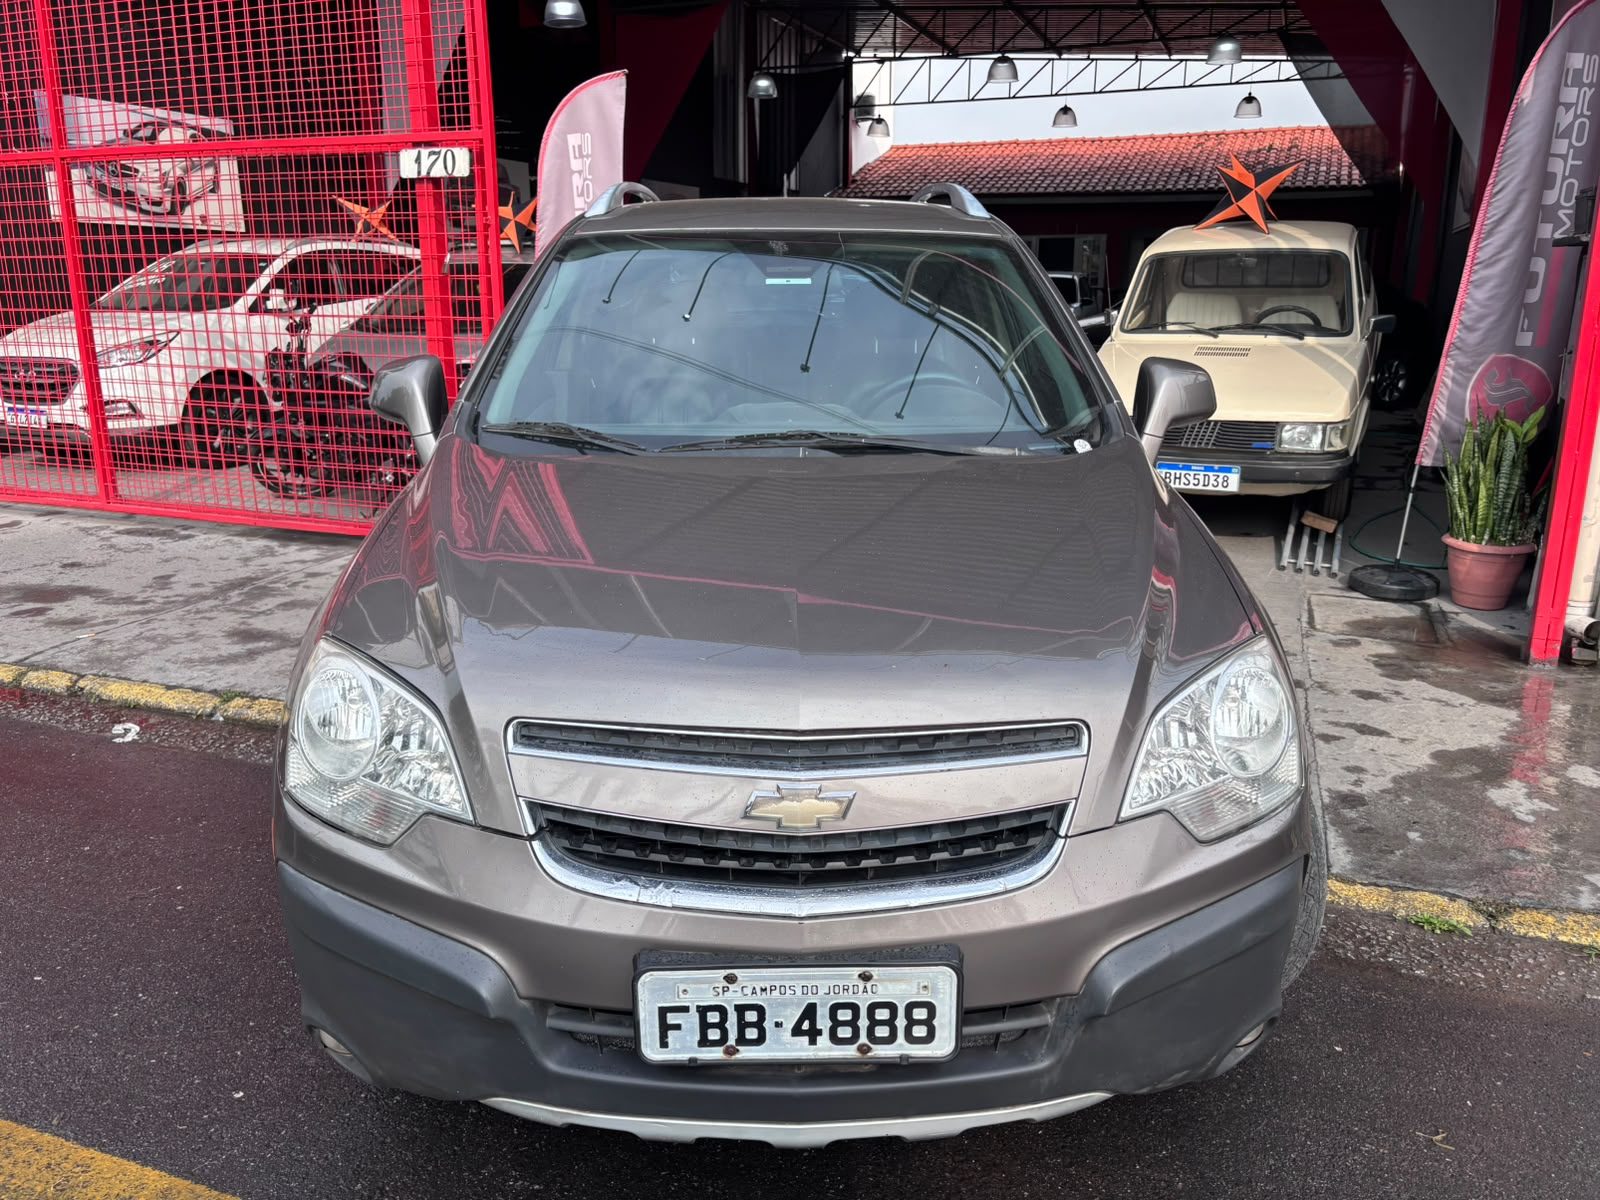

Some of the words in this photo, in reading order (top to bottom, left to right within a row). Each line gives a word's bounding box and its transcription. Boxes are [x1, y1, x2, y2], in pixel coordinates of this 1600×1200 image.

[1553, 54, 1599, 239] MOTORS
[414, 149, 456, 177] 170
[1515, 52, 1584, 346] FUTURA
[1164, 471, 1229, 489] BHS5D38
[801, 984, 819, 996] DO
[824, 982, 879, 996] JORDÃO
